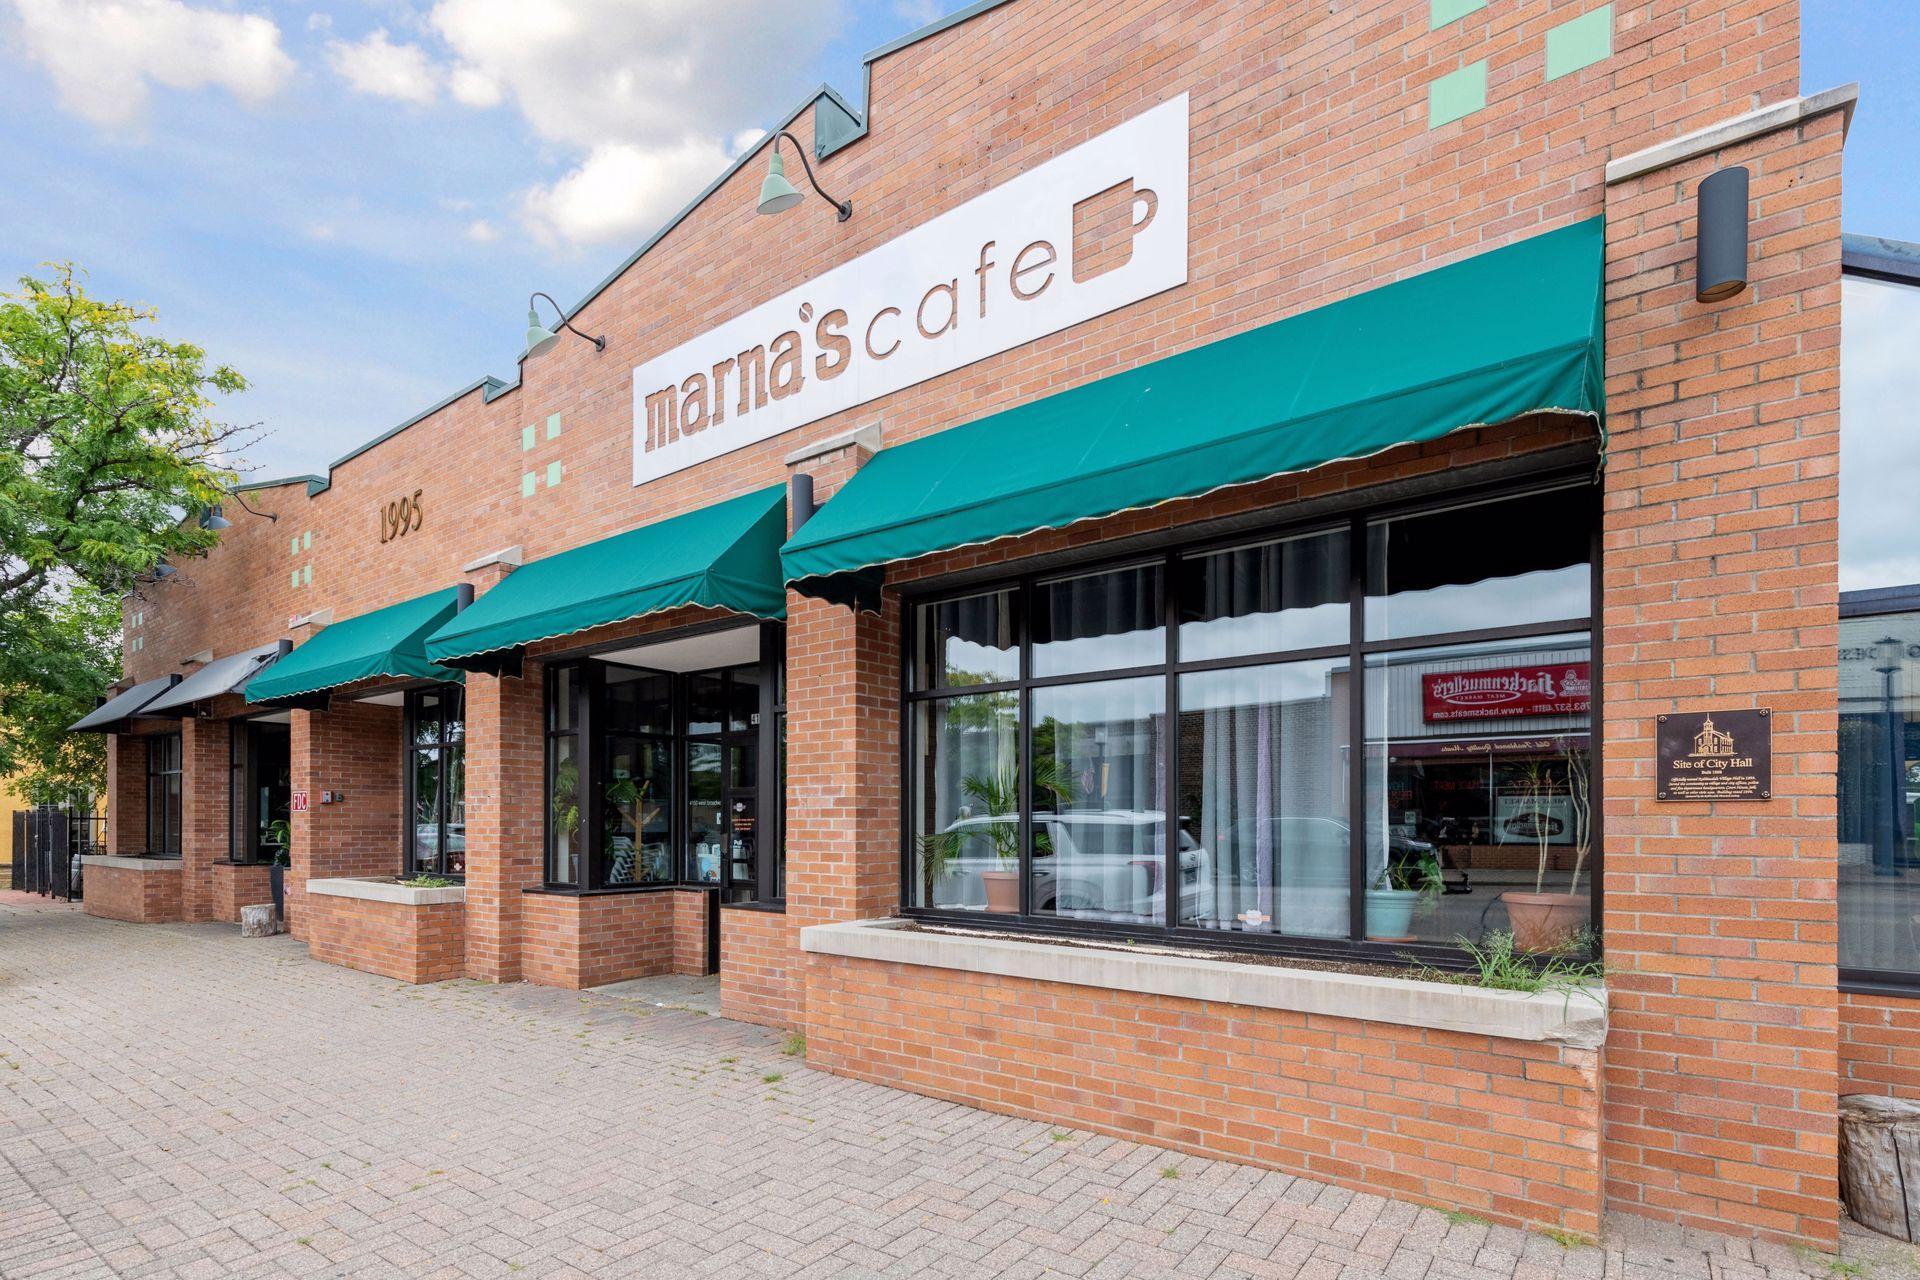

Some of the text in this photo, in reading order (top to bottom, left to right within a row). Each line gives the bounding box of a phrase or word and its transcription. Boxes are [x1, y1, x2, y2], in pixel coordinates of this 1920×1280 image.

[644, 239, 1058, 454] marna's cafe
[380, 489, 423, 544] 1995
[1673, 758, 1753, 769] Site of City Hall
[293, 793, 307, 810] FDC
